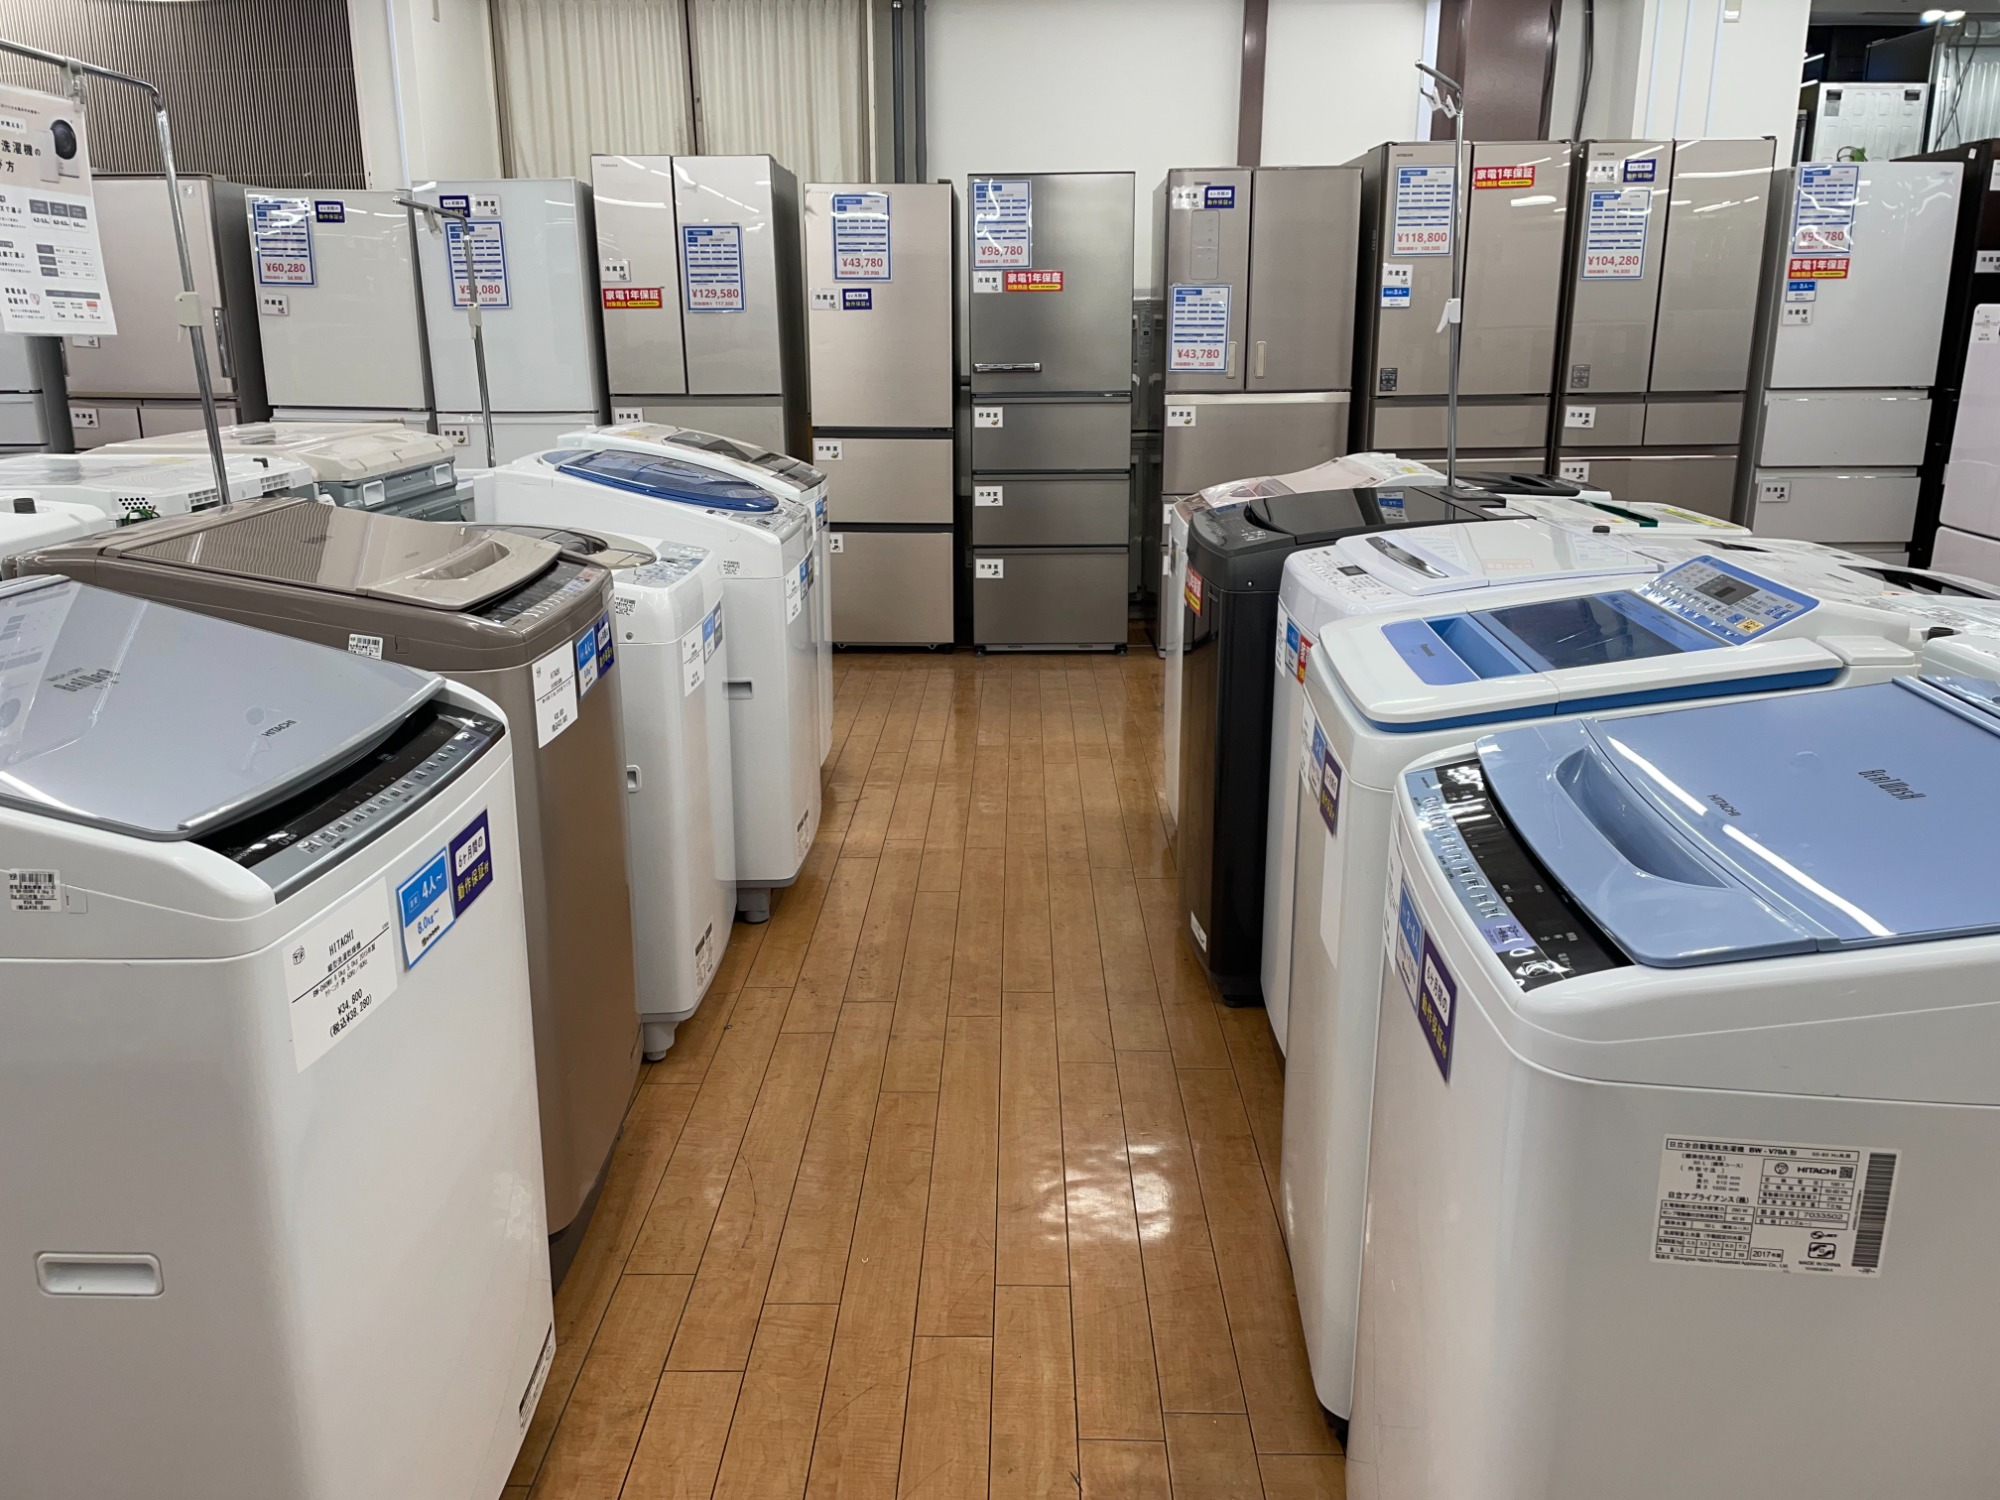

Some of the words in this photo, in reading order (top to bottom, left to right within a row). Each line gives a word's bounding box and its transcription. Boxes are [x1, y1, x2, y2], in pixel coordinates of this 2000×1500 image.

[1, 140, 41, 156] 洗濯機の
[1476, 168, 1533, 180] 家電1年保証
[1397, 232, 1447, 244] ¥118,800
[980, 246, 1023, 257] ¥98,780
[842, 258, 883, 268] ¥43,780
[1587, 256, 1639, 267] ¥104,280
[1791, 260, 1847, 270] 家電1年保証
[265, 263, 305, 274] ¥60,280
[1007, 273, 1061, 283] 家電1年保証
[605, 289, 659, 300] 家電1年保証
[692, 288, 739, 300] ¥129,580
[1177, 349, 1220, 360] ¥43,780
[261, 719, 297, 737] HITACHI
[1707, 794, 1741, 817] HITACHI
[458, 836, 484, 868] 6ヶ月間の
[456, 860, 489, 902] 動作保証付
[328, 929, 355, 956] HITACHI
[1669, 1141, 1744, 1153] 日立全自動電気洗濯機
[1797, 1166, 1837, 1175] HITACHI
